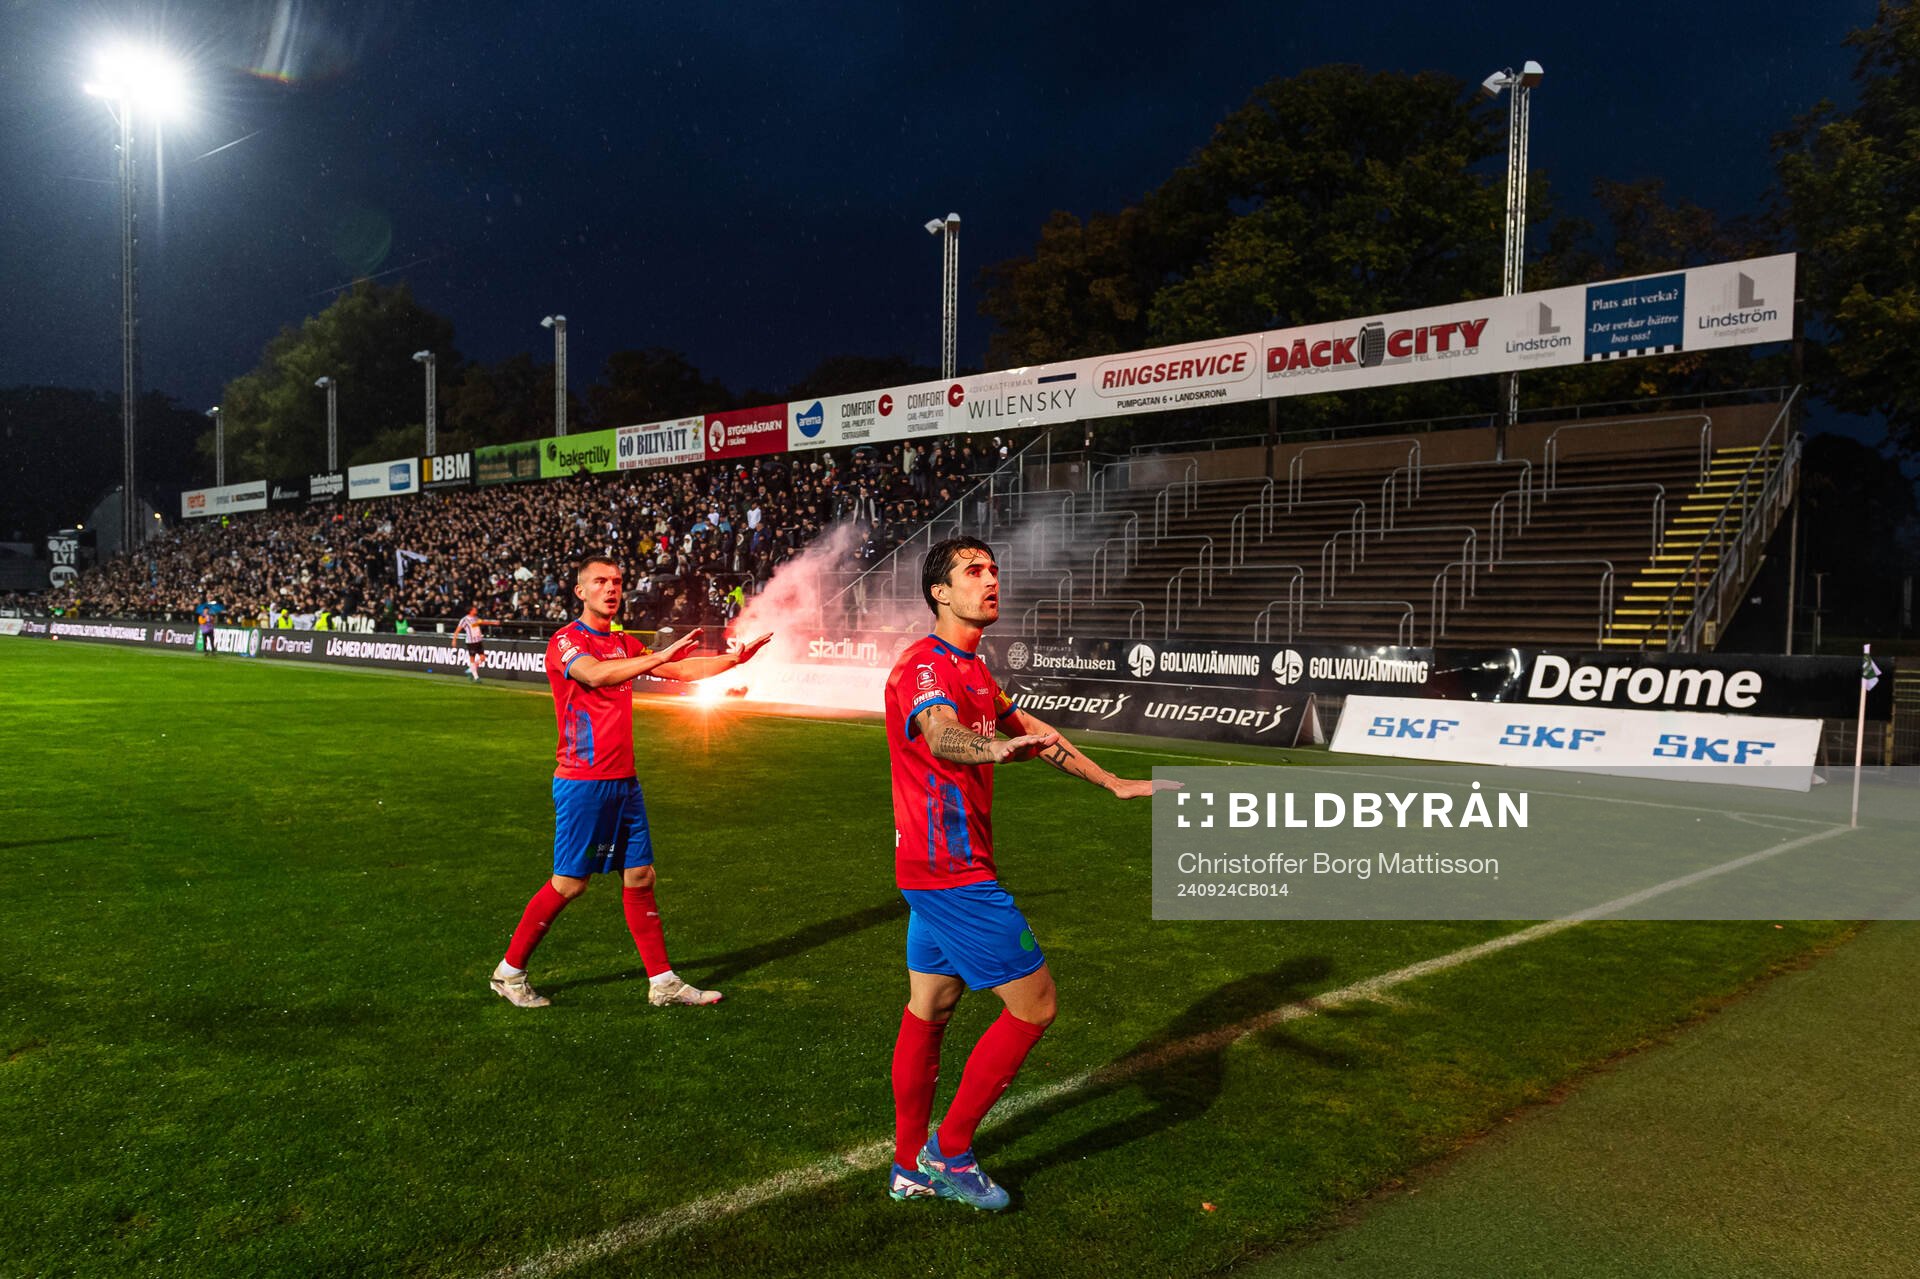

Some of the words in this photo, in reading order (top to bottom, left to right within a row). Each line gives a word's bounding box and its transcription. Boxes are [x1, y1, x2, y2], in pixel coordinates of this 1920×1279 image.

[1592, 299, 1618, 311] Plats
[1621, 296, 1637, 307] att
[1640, 289, 1679, 304] verka?
[1613, 318, 1645, 330] verkar
[1647, 314, 1679, 326] bättre
[1698, 308, 1777, 330] Lindström
[1267, 338, 1357, 374] DÄCK
[1387, 318, 1489, 358] CITY
[1506, 335, 1571, 353] Lindström
[1631, 330, 1651, 341] oss!
[1101, 351, 1248, 390] RINGSERVICE
[841, 400, 876, 418] COMFORT
[907, 391, 945, 410] COMFORT
[968, 388, 1077, 419] WILENSKY
[1117, 396, 1160, 409] PUMPGATAN
[1175, 388, 1227, 402] LANDSKRONA
[619, 435, 634, 457] GO
[637, 426, 687, 456] BILTVÄTT
[432, 453, 470, 481] BBM
[559, 446, 611, 467] bakertilly
[326, 637, 342, 656] LÄS
[342, 640, 360, 658] MER
[361, 641, 375, 659] OM
[375, 642, 405, 661] DIGITAL
[406, 644, 456, 665] SKYLTNING
[808, 636, 877, 660] stadium
[1033, 653, 1116, 671] Borstahusen
[1160, 650, 1260, 676] GOLVAVJÄMNING
[1309, 656, 1429, 684] GOLVAVJÄMNING
[1527, 654, 1763, 709] Derome
[1011, 693, 1114, 714] UNISPORT
[1144, 702, 1270, 728] UNISPORT
[1367, 716, 1459, 740] SKF
[1498, 723, 1606, 751] SKF
[1652, 733, 1775, 765] SKF
